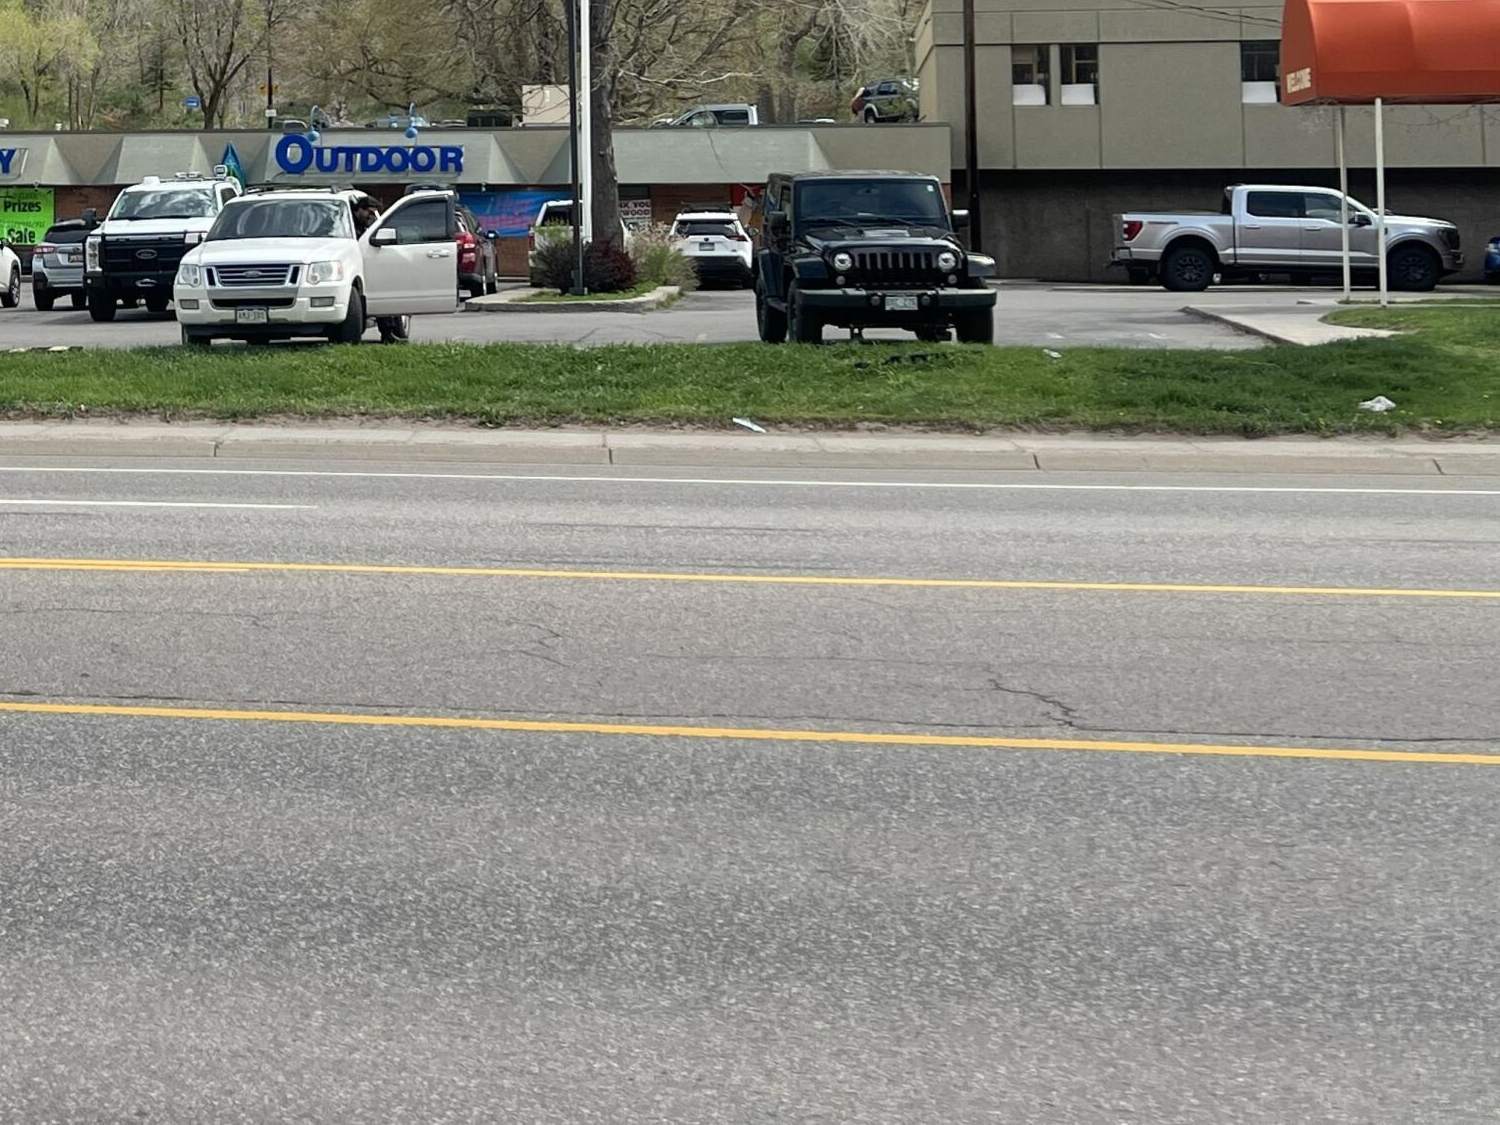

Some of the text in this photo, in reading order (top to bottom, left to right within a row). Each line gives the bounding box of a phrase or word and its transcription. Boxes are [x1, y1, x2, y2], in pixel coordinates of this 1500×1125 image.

[275, 132, 464, 175] OUTDOOR
[3, 197, 42, 213] Prizes
[6, 227, 36, 244] Sale
